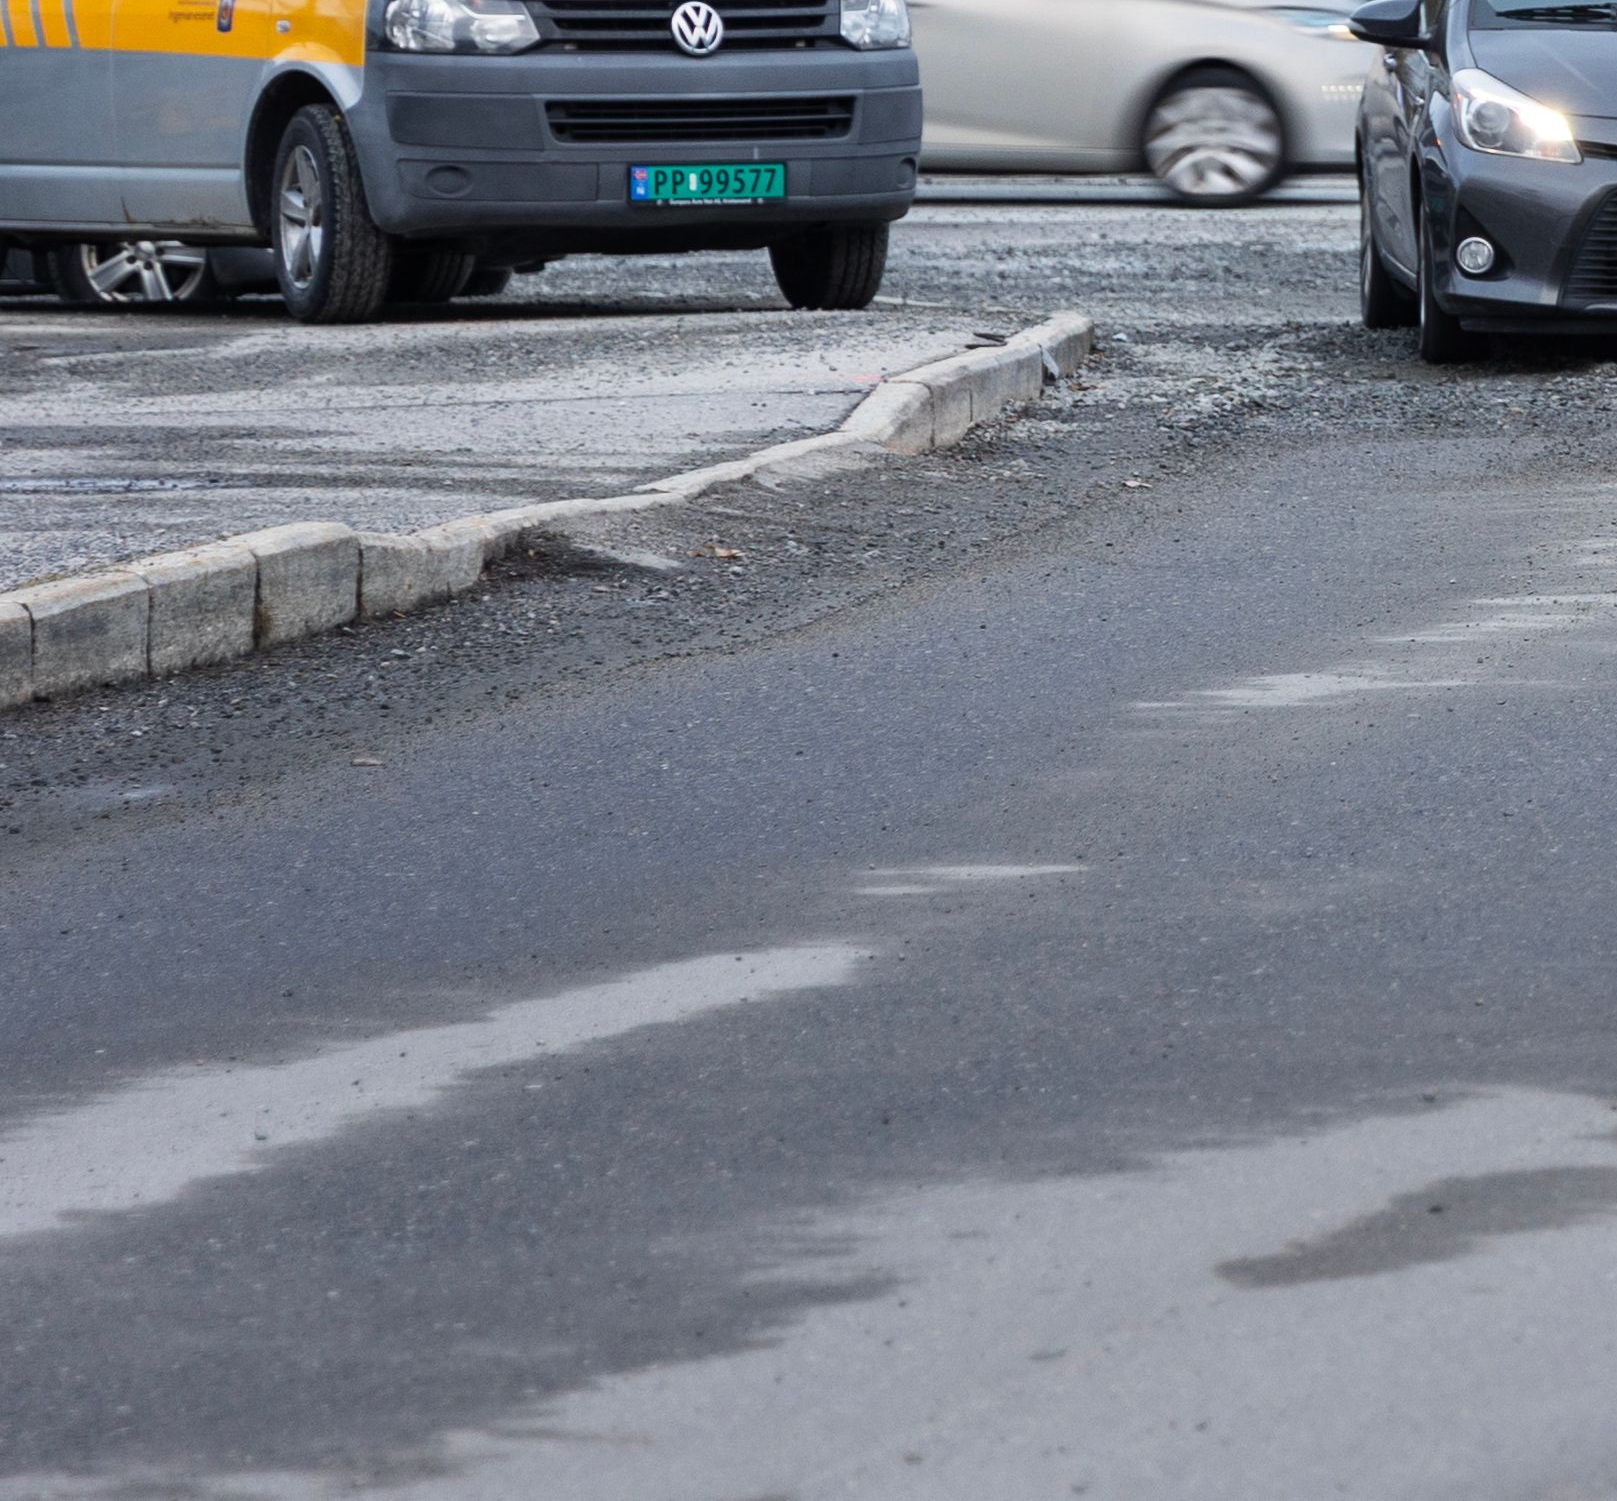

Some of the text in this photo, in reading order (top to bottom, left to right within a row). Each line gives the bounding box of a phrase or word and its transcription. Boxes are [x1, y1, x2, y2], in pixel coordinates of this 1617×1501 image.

[672, 1, 724, 54] VW
[654, 168, 777, 195] PP 99577
